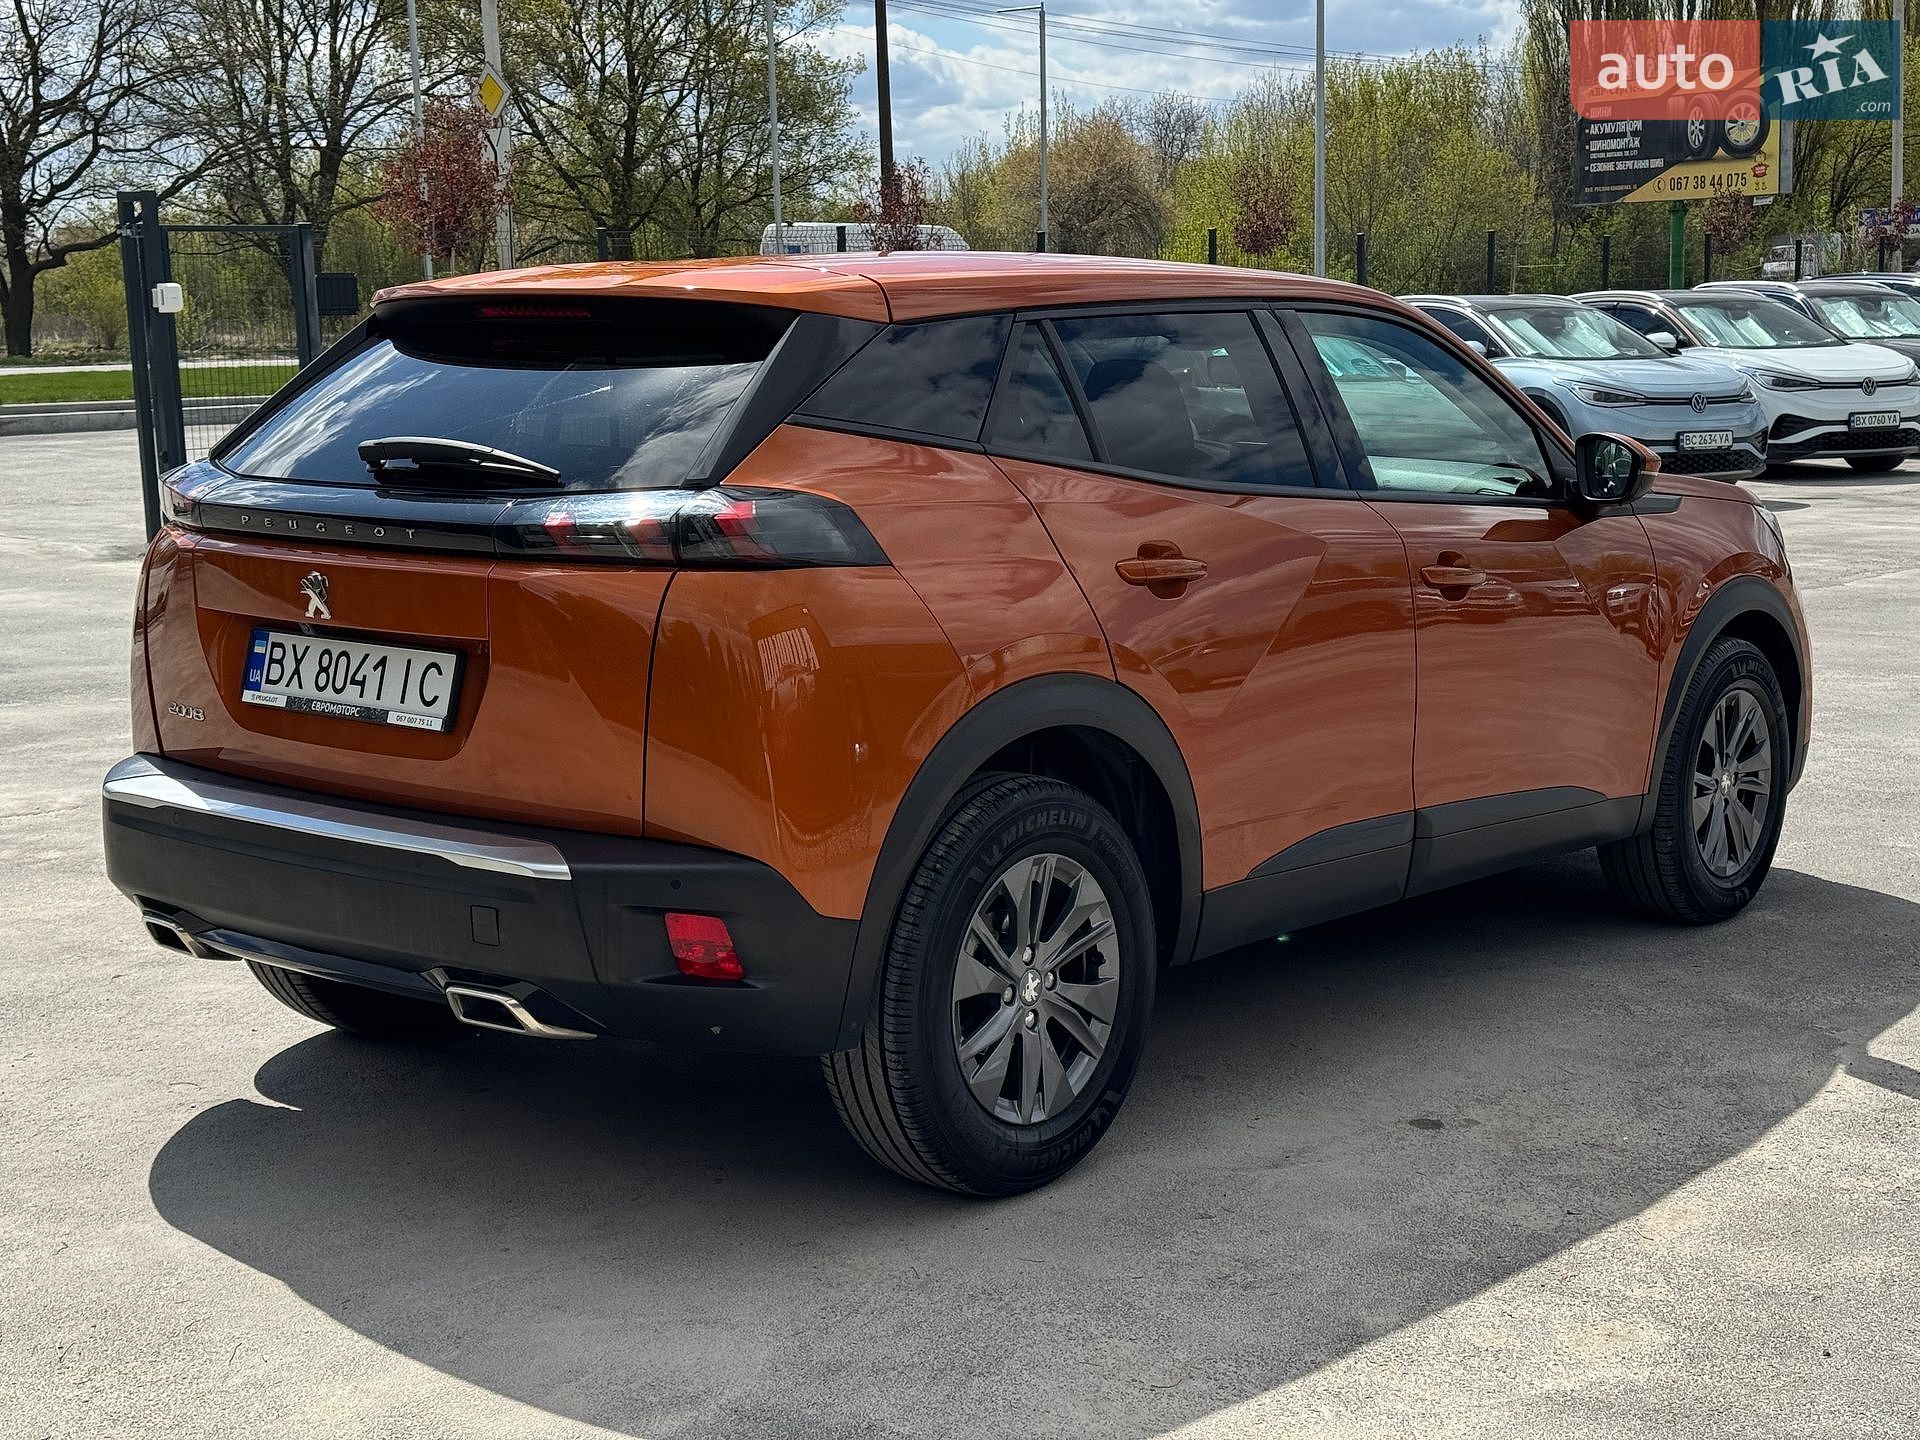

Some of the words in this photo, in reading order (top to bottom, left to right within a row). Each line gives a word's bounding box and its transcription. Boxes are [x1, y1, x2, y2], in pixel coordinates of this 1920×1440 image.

[1590, 120, 1643, 135] АКУМУЛЯТОРИ
[1590, 136, 1641, 152] ШИНОМОНТАЖ
[1669, 176, 1690, 192] 067
[1693, 175, 1706, 190] 38
[1709, 174, 1723, 189] 44
[1726, 172, 1747, 188] 075
[1855, 416, 1867, 426] BX
[1887, 414, 1898, 424] YA
[1685, 434, 1697, 446] BC
[1698, 433, 1718, 445] 2634
[1718, 433, 1730, 444] YA
[241, 514, 415, 540] PEUGEOT
[249, 668, 261, 683] UA
[264, 641, 310, 690] BX
[314, 648, 388, 701] 8041
[400, 658, 443, 708] IC
[168, 702, 205, 721] 2008
[426, 719, 433, 727] 11
[1001, 810, 1087, 848] MICHELIN
